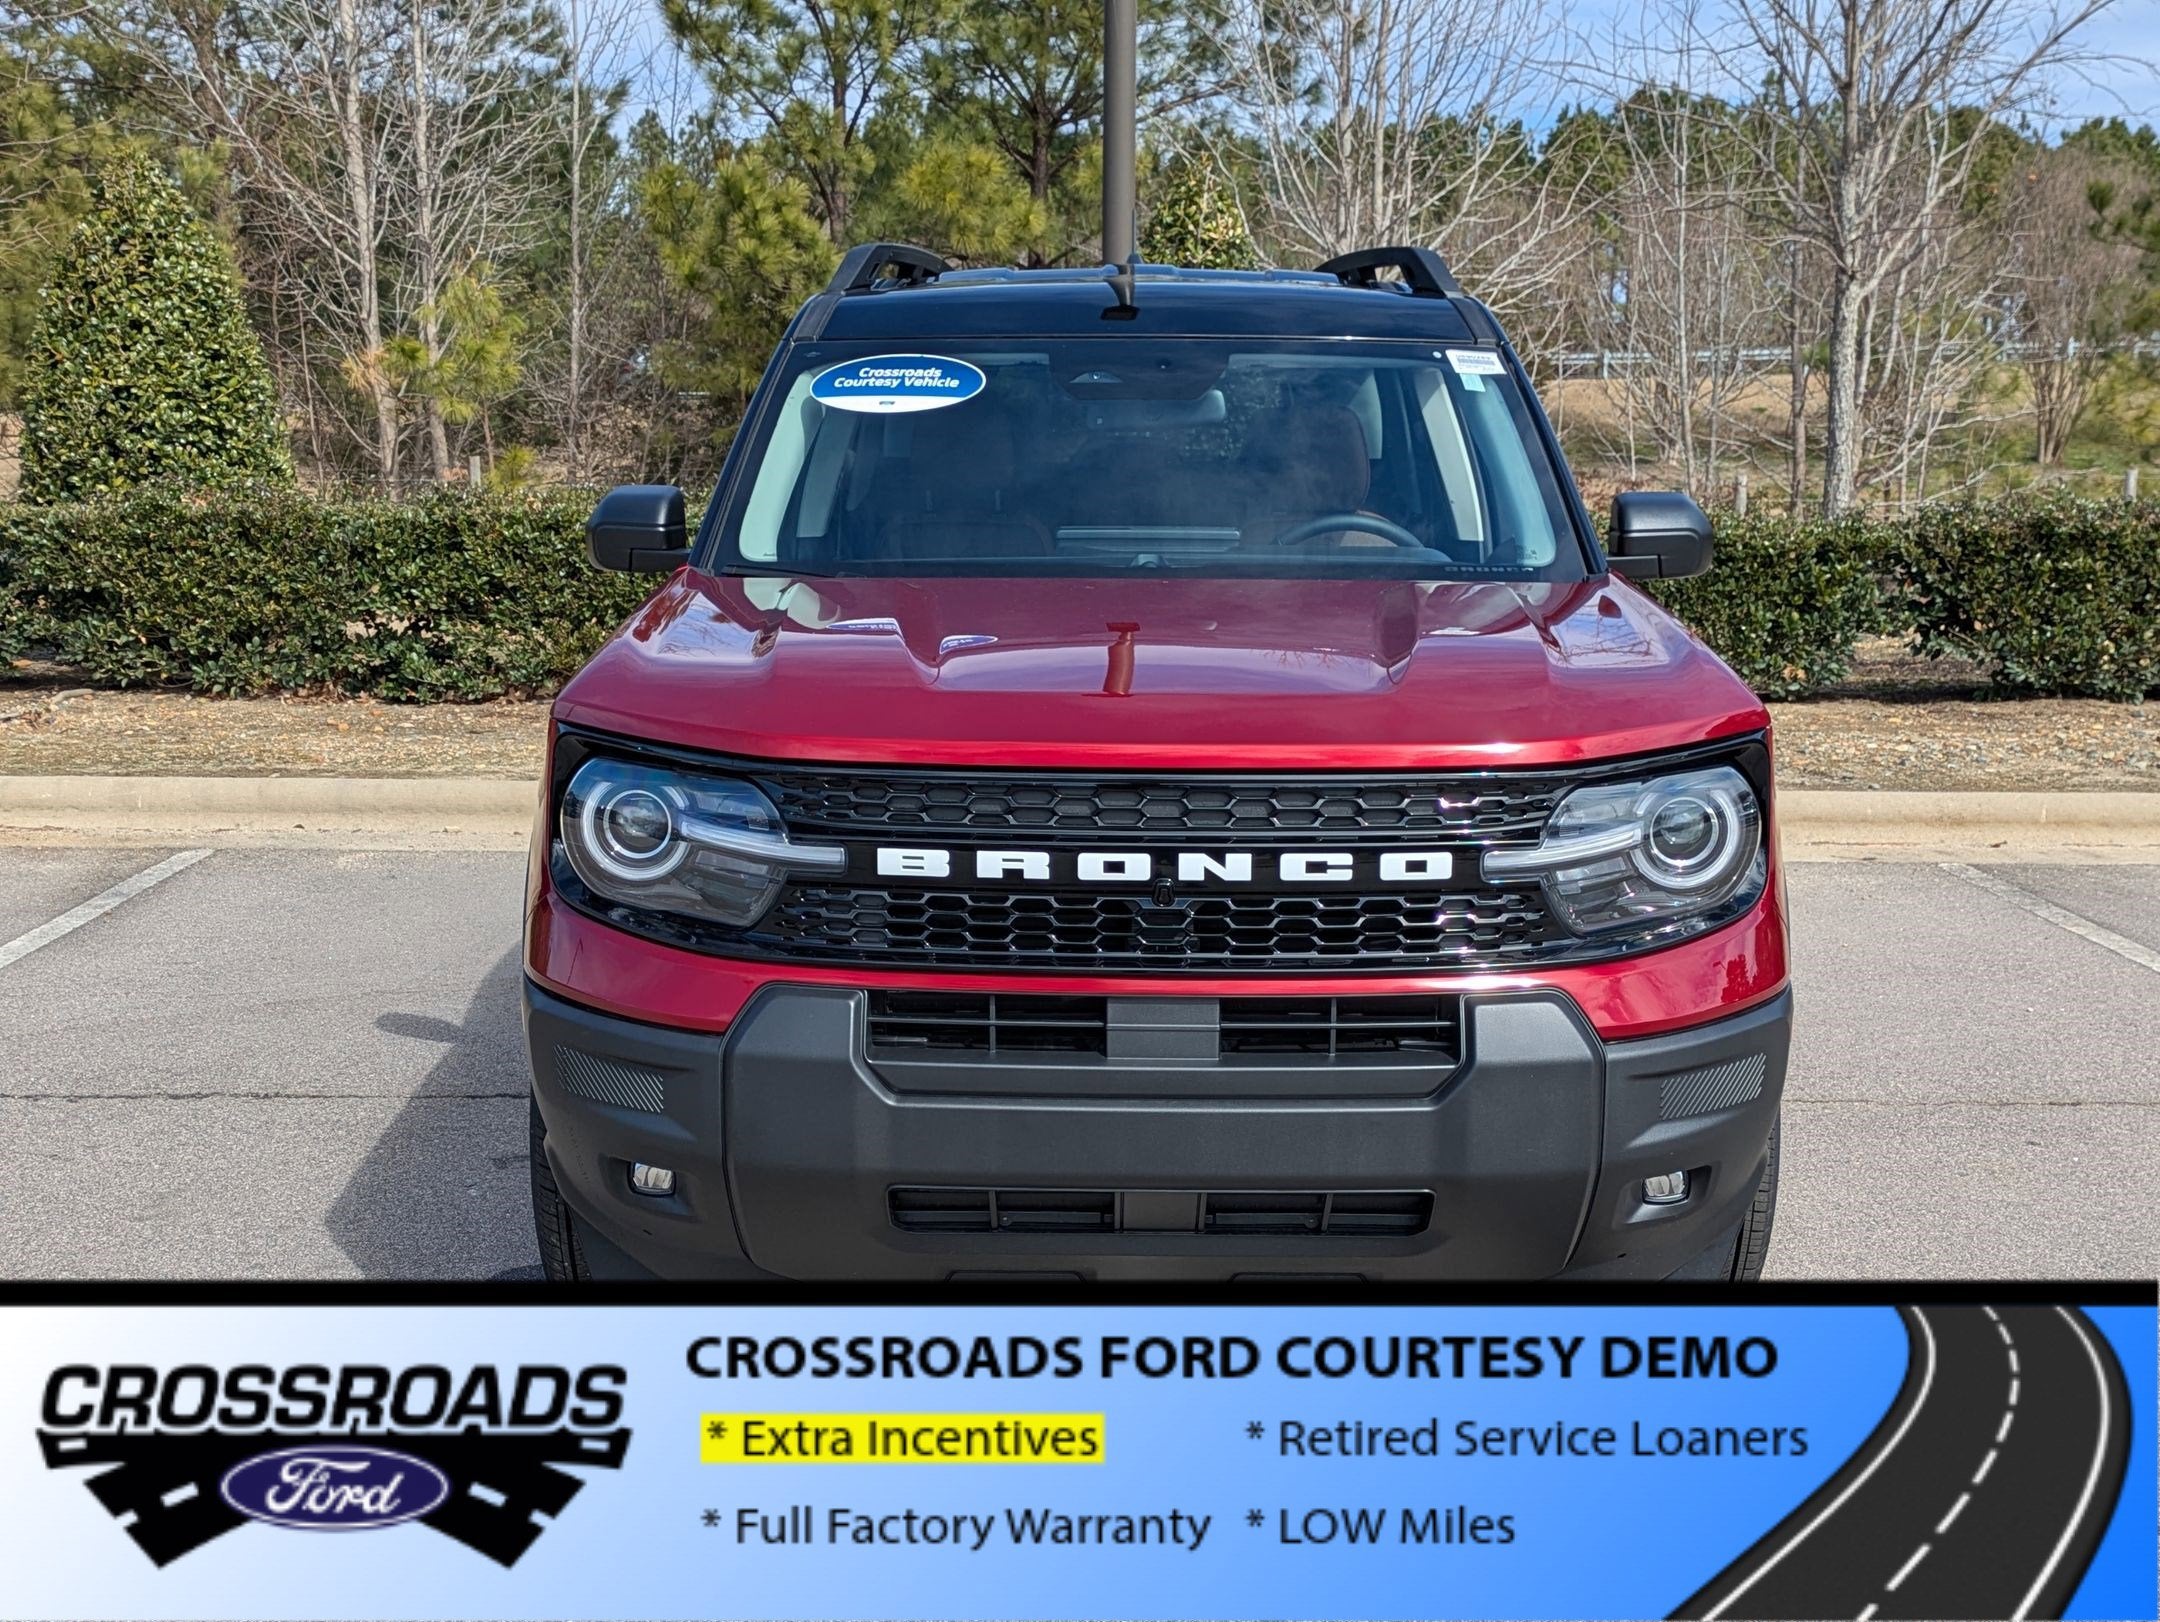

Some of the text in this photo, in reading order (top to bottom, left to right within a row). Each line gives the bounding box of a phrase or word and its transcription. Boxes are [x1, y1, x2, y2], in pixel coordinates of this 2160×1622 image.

[858, 367, 942, 378] Crossroads
[833, 377, 960, 388] Courtesy Vehicle
[877, 848, 1453, 882] BRONCO
